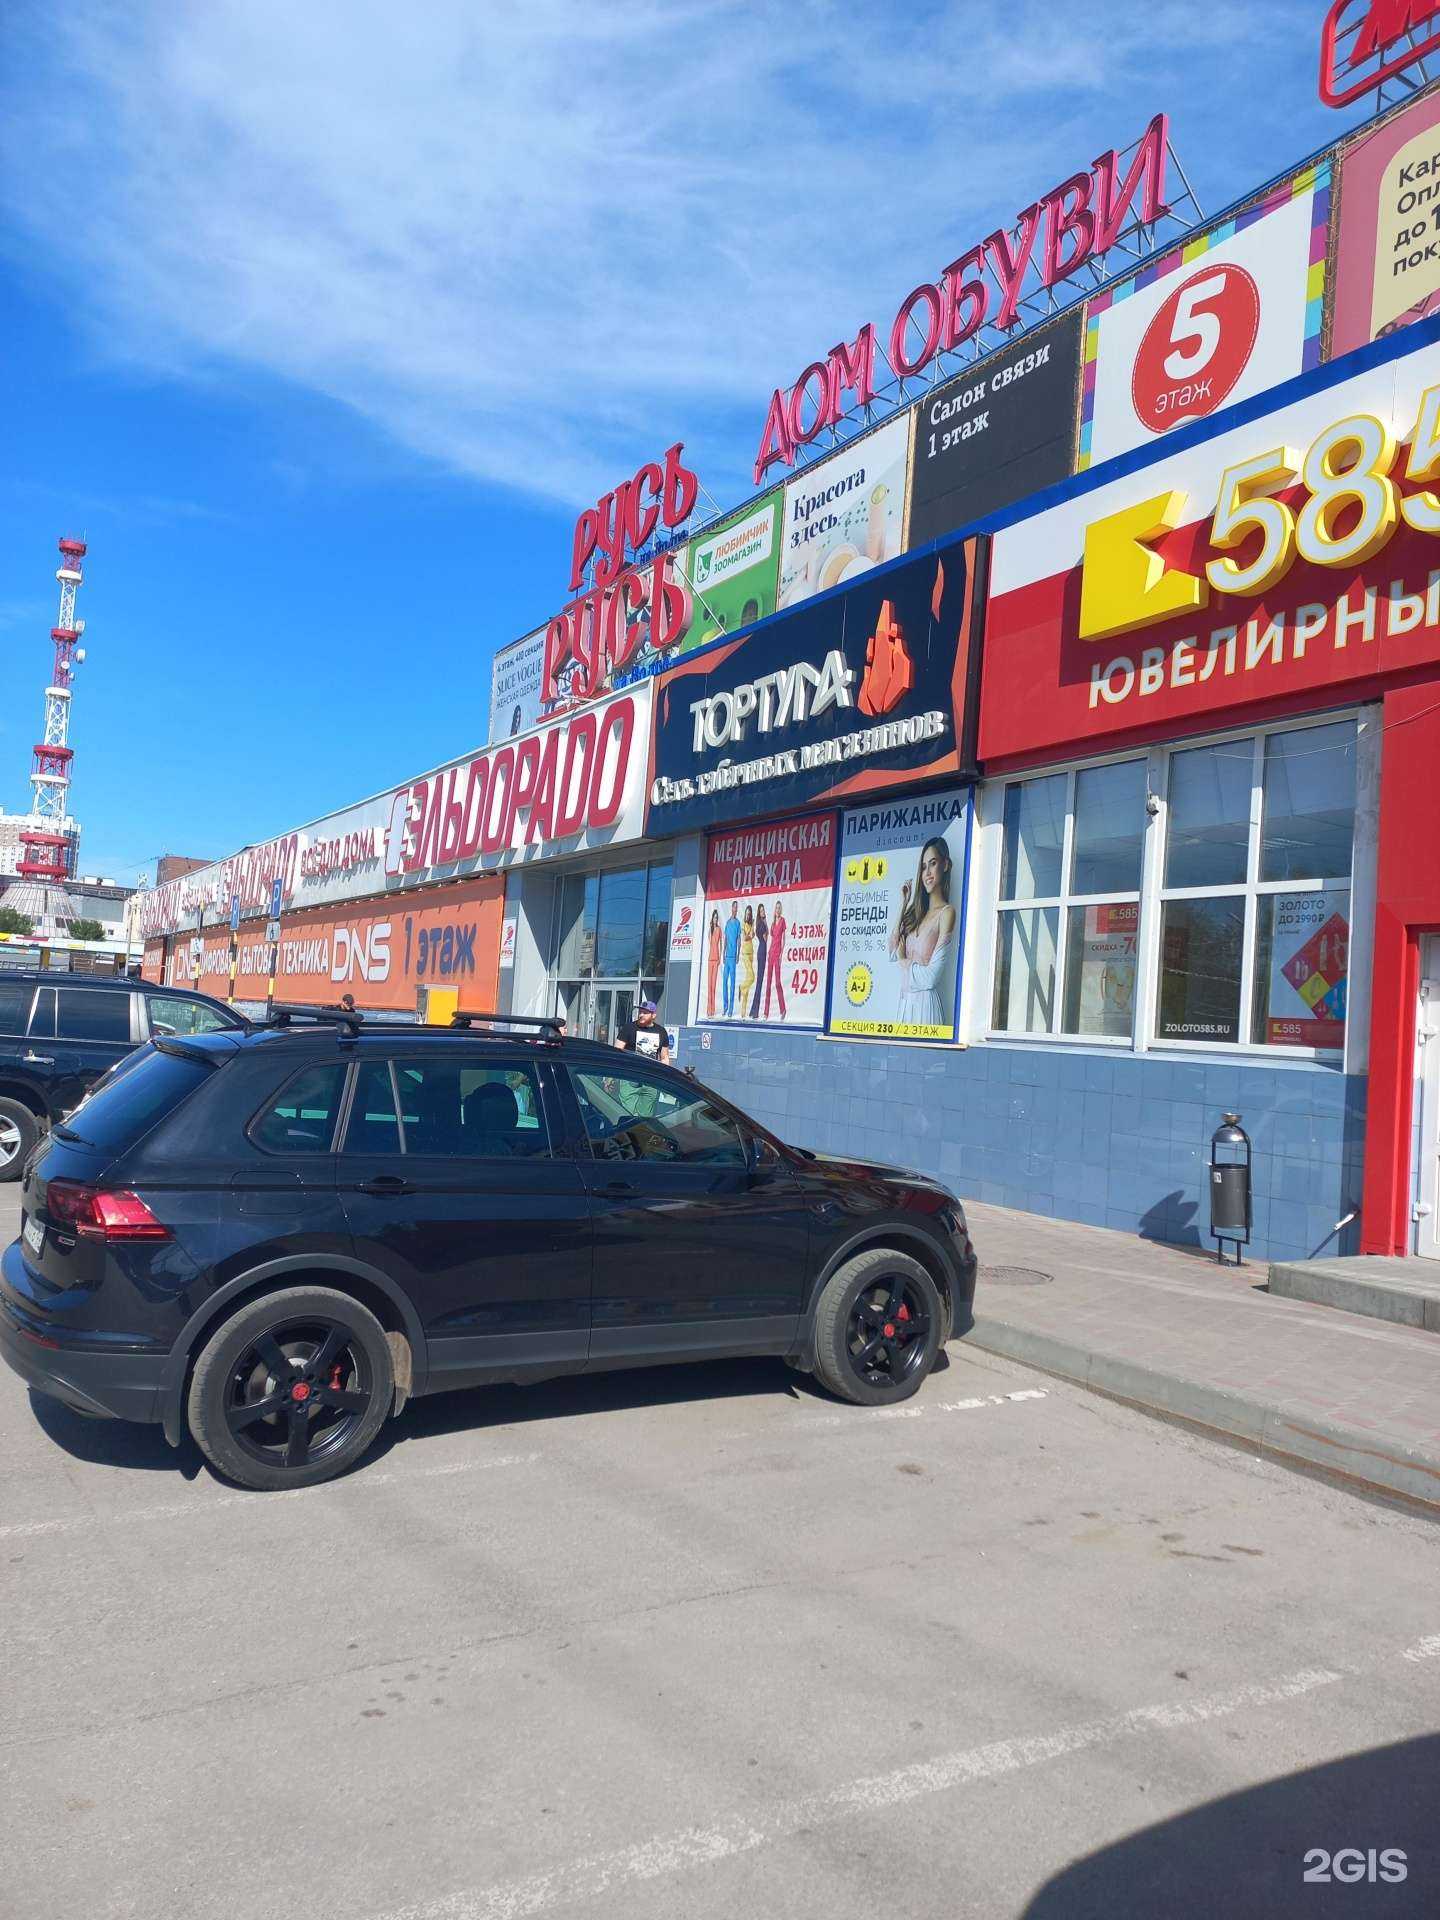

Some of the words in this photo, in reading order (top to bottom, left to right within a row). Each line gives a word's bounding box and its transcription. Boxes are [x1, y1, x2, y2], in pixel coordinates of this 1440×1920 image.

[1393, 221, 1426, 252] до
[1393, 242, 1440, 276] пок
[754, 323, 875, 485] ДОМ
[891, 113, 1170, 376] ОБУВИ
[1163, 272, 1227, 380] 5
[930, 382, 986, 426] Салон
[991, 343, 1051, 391] связи
[1154, 377, 1214, 414] этаж
[927, 433, 936, 459] 1
[941, 412, 990, 453] этаж
[793, 467, 865, 521] Красота
[1205, 384, 1440, 597] 585
[568, 441, 698, 593] РУСЬ
[790, 513, 838, 549] здесь
[713, 539, 762, 575] ЗООМАГАЗИН
[714, 519, 769, 561] ЛЮБИМЧИК
[540, 552, 692, 703] РУСЬ
[689, 649, 857, 753] ТОРТУГА
[696, 758, 799, 794] табачных
[799, 710, 948, 771] магазинов
[847, 799, 963, 836] ПАРИЖАНКА
[713, 819, 831, 864] МЕДИЦИНСКАЯ
[732, 857, 802, 895] ОДЕЖДА
[841, 905, 889, 924] БРЕНДЫ
[842, 889, 889, 905] ЛЮБИМЫЕ
[1279, 899, 1326, 911] ЗОЛОТО
[790, 923, 797, 939] 4
[1279, 914, 1294, 926] ДО
[283, 938, 329, 975] ТЕХНИКА
[331, 923, 393, 982] DNS
[402, 916, 414, 976] 1
[416, 923, 478, 979] этаж
[672, 937, 692, 945] РУСЬ
[787, 945, 826, 966] секция
[791, 968, 818, 995] 429
[841, 1021, 875, 1032] СЕКЦИЯ
[877, 1024, 894, 1033] 230
[903, 1024, 909, 1034] 2
[911, 1025, 939, 1036] ЭТАЖ
[1165, 1023, 1231, 1034] ZOLOTO585.RU
